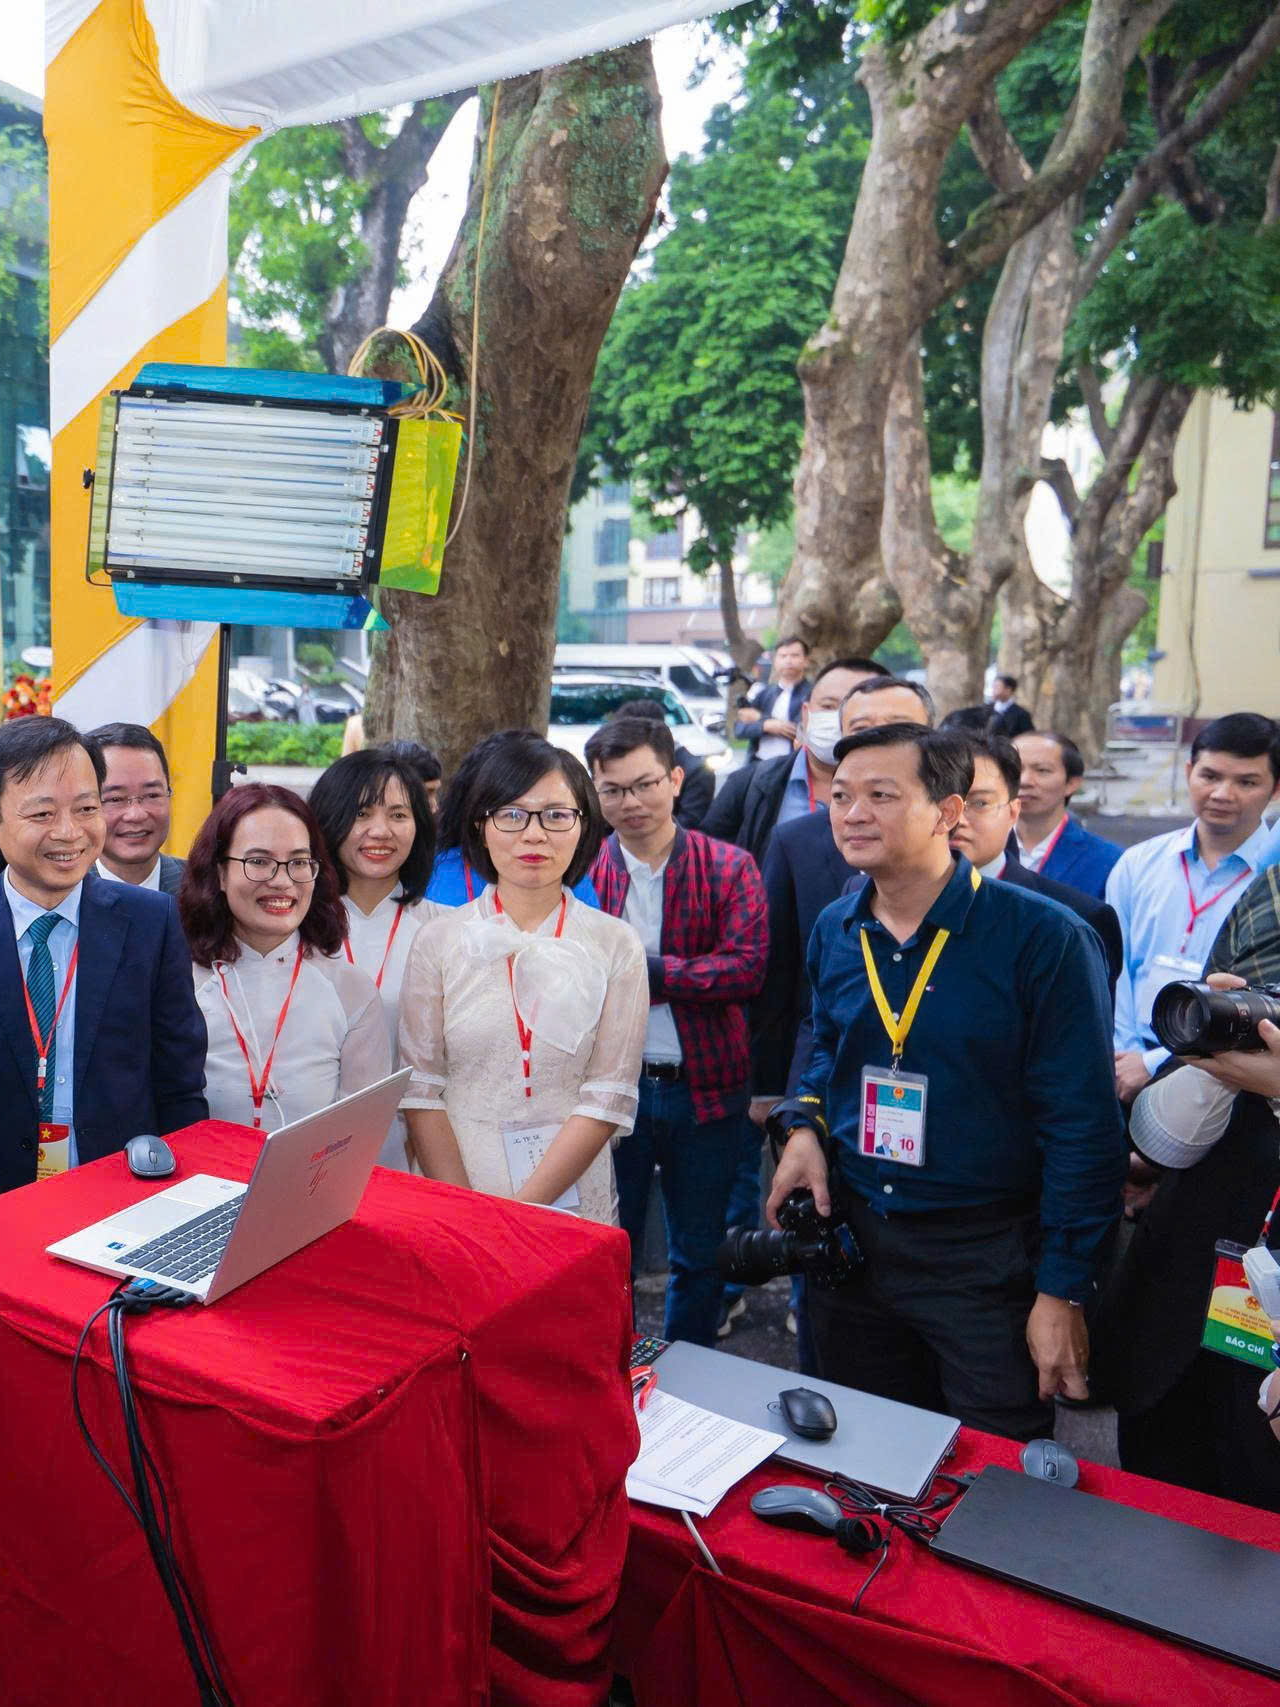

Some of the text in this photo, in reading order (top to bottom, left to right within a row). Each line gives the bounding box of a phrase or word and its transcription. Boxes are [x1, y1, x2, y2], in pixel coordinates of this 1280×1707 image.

[899, 1137, 914, 1151] 10
[1225, 1335, 1265, 1356] BÁO CHÍ
